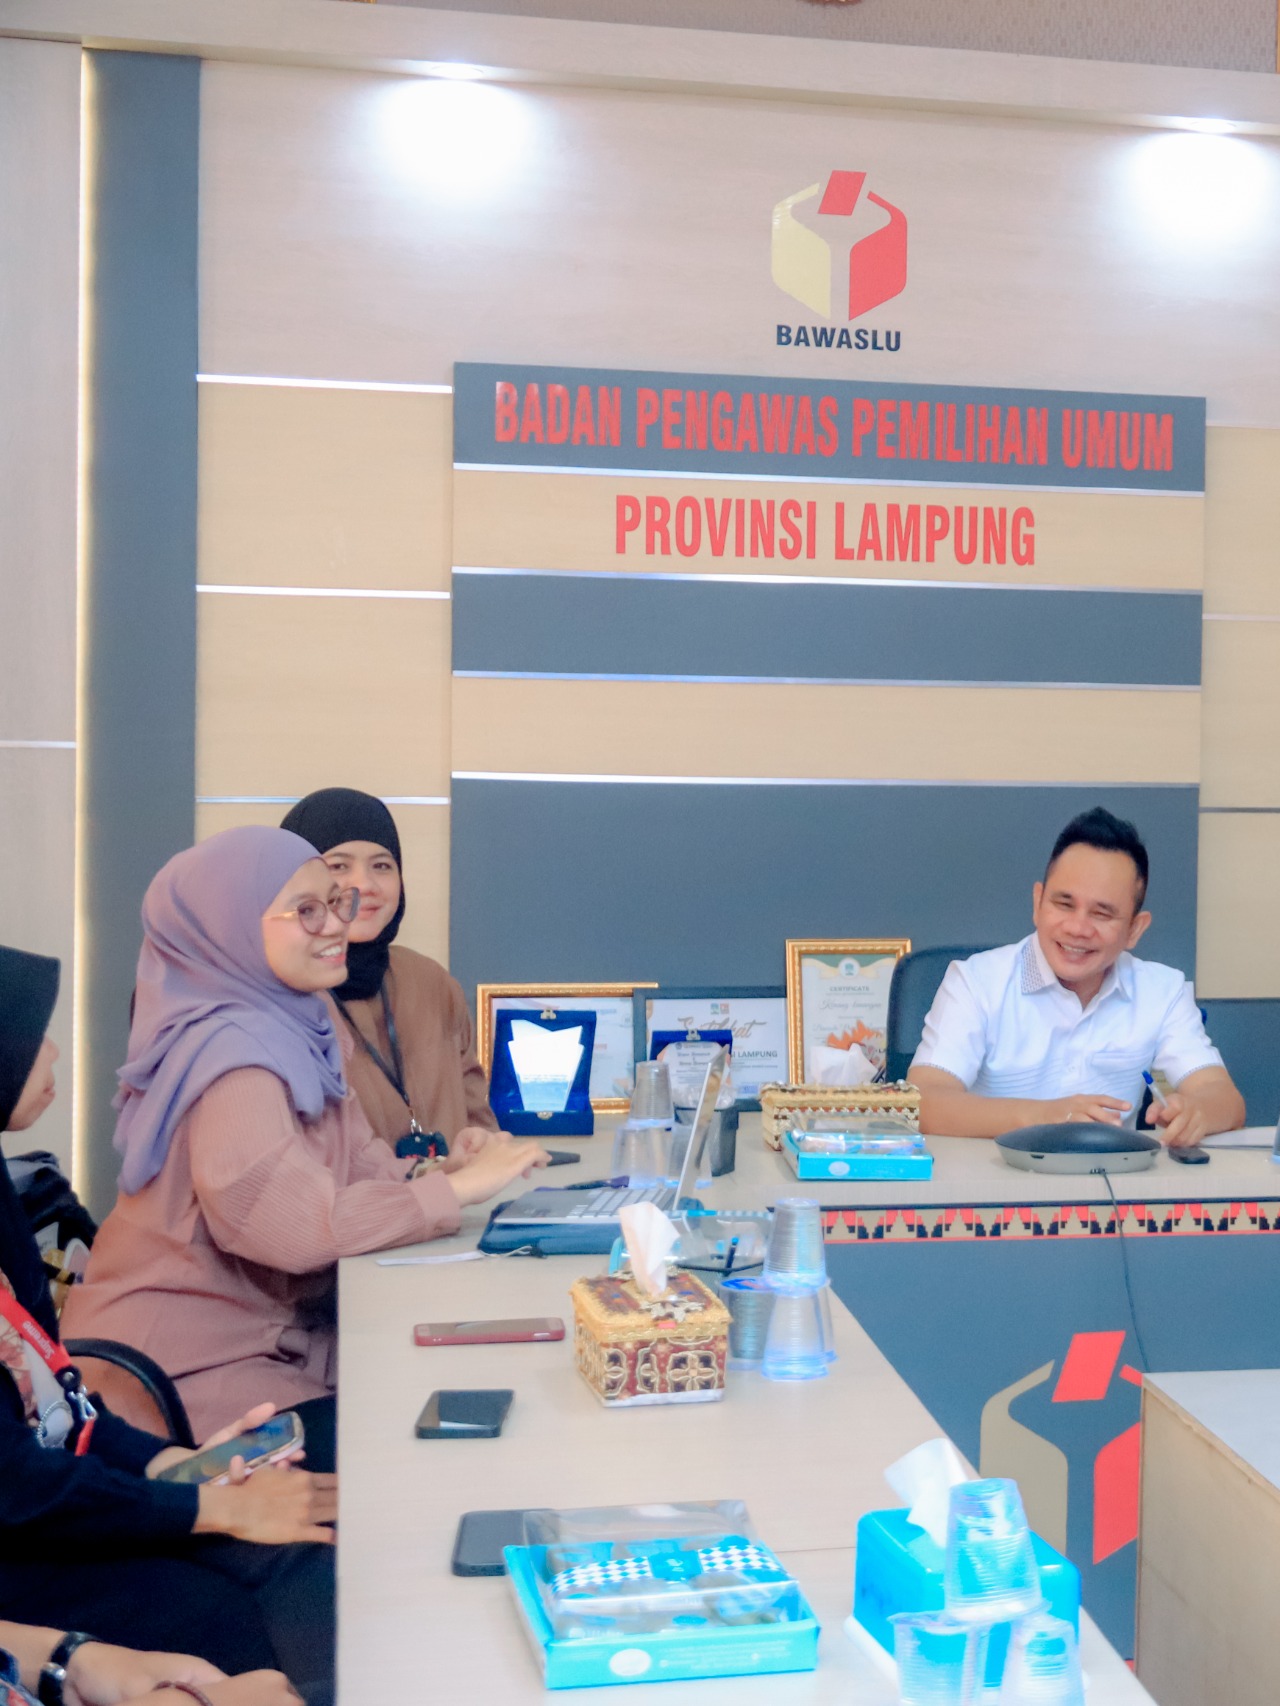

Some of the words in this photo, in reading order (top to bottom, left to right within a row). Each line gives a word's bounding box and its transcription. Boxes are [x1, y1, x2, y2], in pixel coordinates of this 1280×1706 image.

[776, 323, 902, 353] BAWASLU
[494, 381, 622, 447] BADAN
[637, 388, 839, 458] PENGAWAS
[852, 398, 1049, 466] PEMILIHAN
[1062, 408, 1174, 472] UMUM
[615, 494, 817, 561] PROVINSI
[834, 500, 1036, 567] LAMPUNG
[737, 1050, 778, 1058] LAMPUNG
[22, 1320, 55, 1360] Supreme
